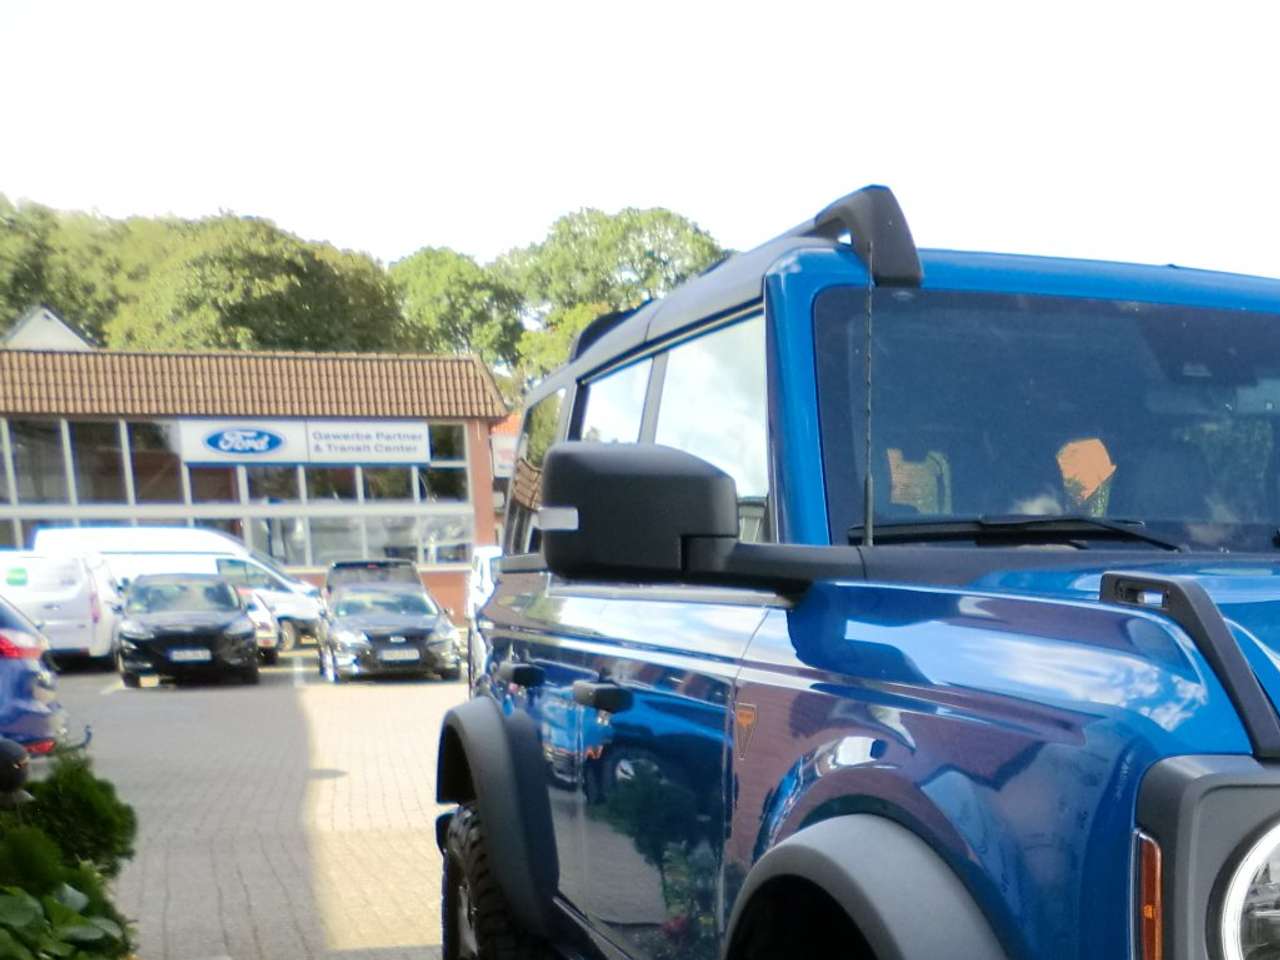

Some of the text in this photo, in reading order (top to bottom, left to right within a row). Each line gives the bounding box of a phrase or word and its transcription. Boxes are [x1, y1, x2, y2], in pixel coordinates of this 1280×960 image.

[219, 430, 270, 452] Ford
[326, 443, 370, 452] Transit
[374, 444, 417, 453] Center
